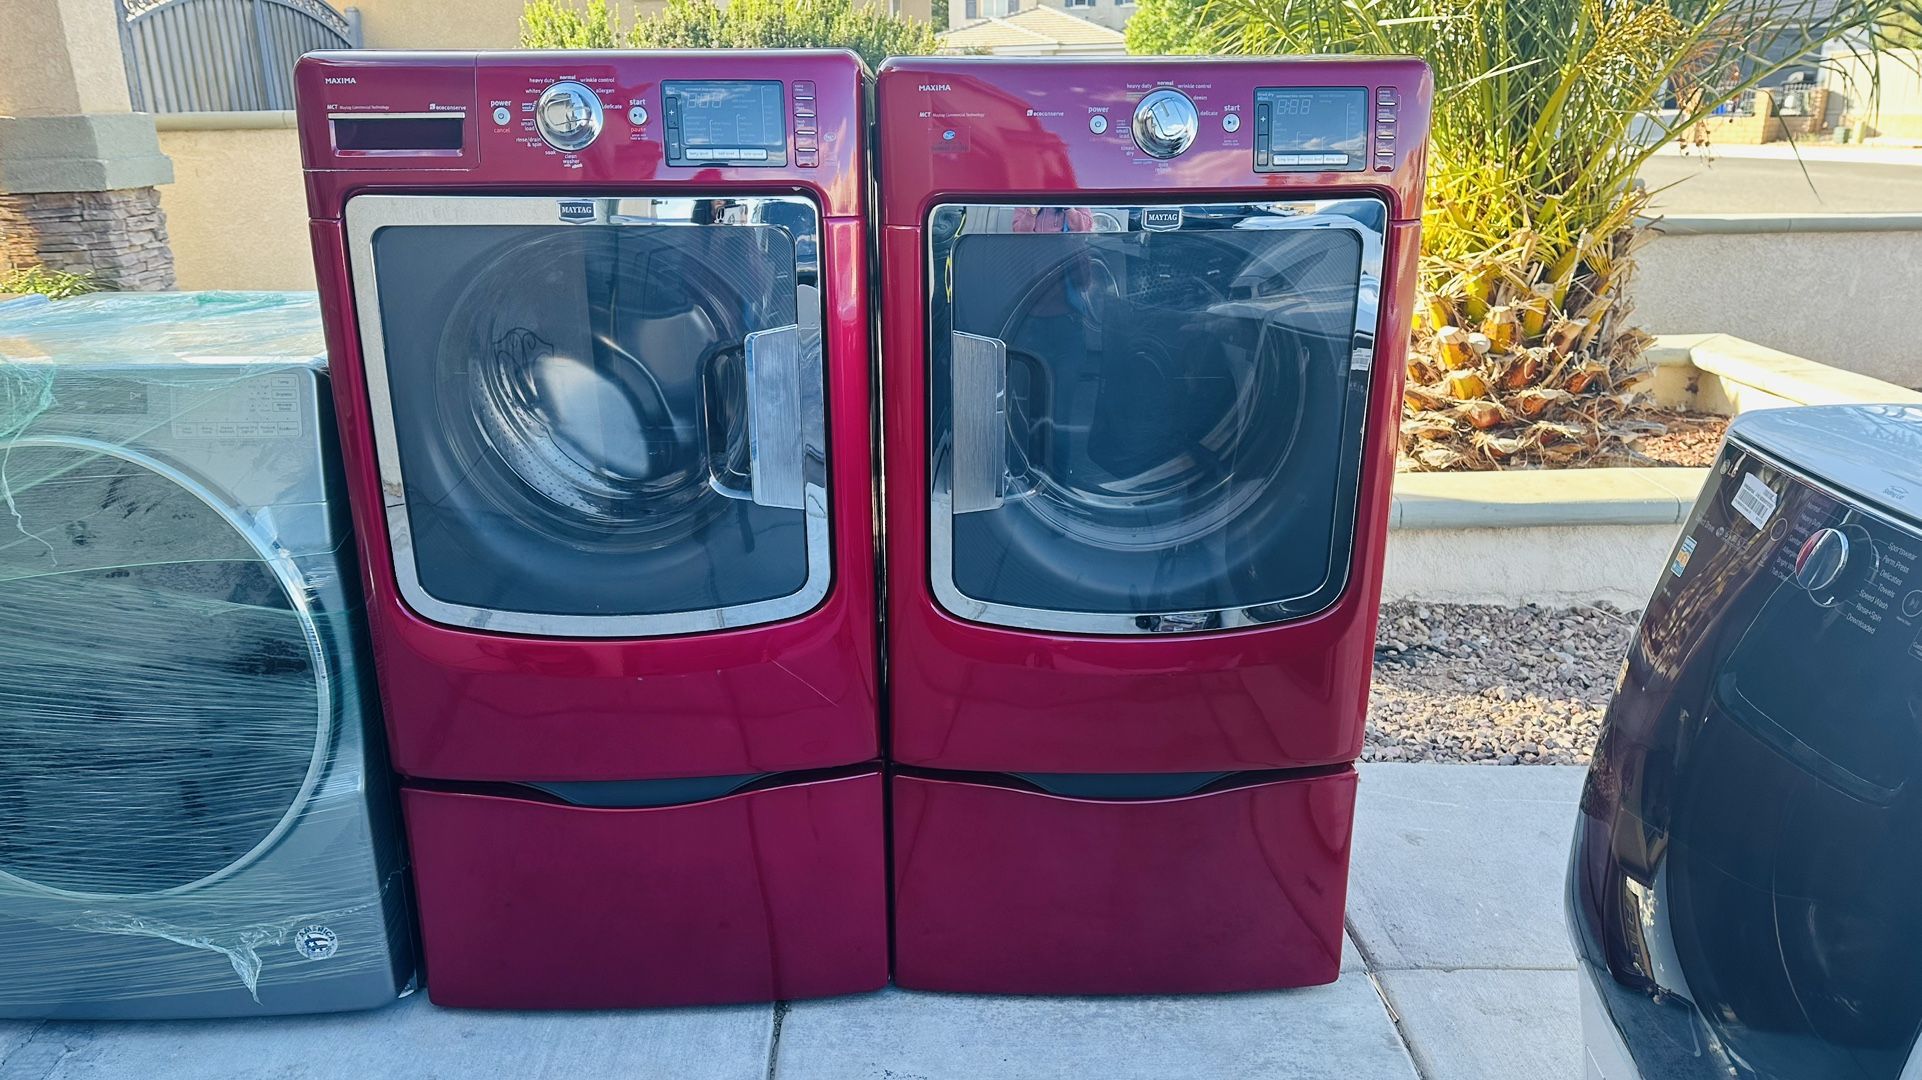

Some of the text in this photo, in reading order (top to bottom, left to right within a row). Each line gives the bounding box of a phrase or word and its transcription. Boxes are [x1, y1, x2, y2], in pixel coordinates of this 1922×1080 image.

[490, 100, 511, 108] power
[561, 206, 592, 214] MAYTAG
[1149, 213, 1178, 221] MAYTAG
[1888, 542, 1918, 561] Sportswear
[1880, 569, 1903, 586] Delicates
[1878, 583, 1896, 599] Towels
[1859, 589, 1889, 610] Speed Wash
[1846, 612, 1876, 635] Downloaded
